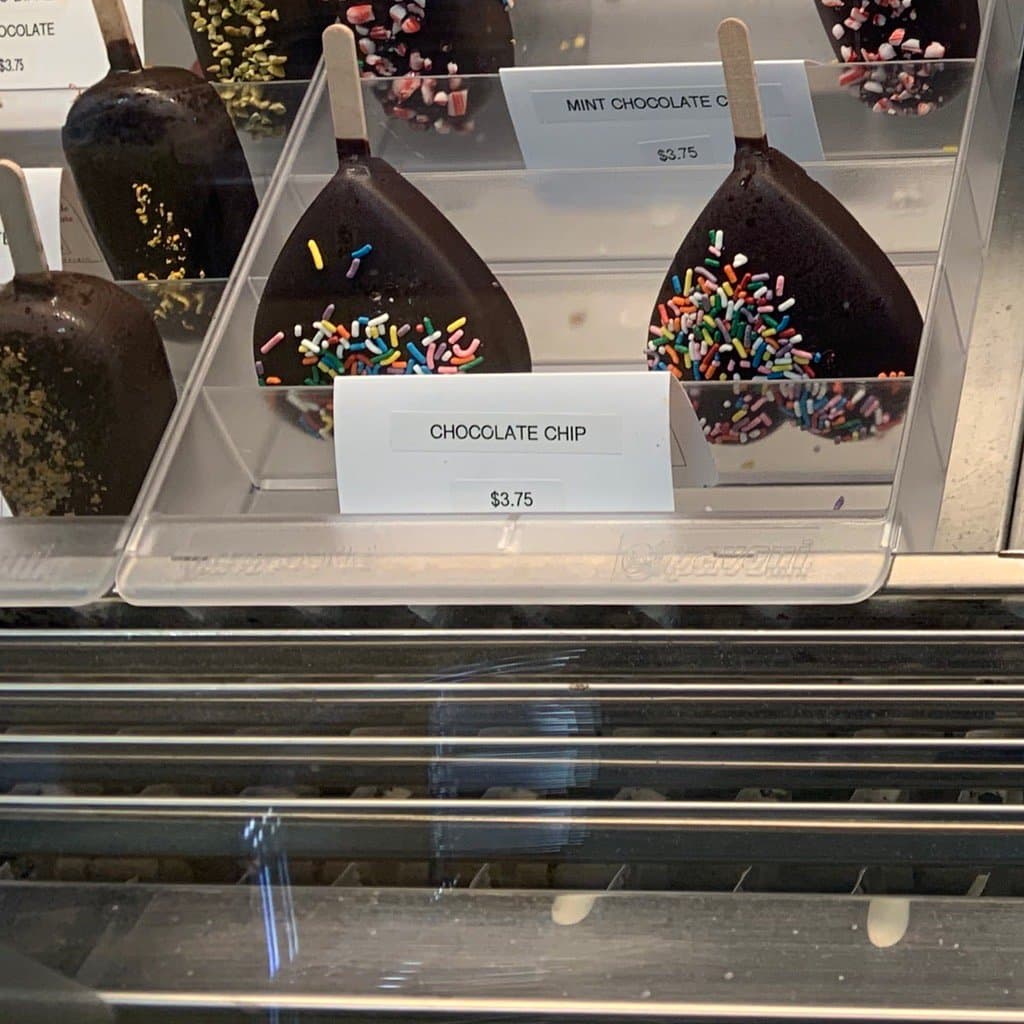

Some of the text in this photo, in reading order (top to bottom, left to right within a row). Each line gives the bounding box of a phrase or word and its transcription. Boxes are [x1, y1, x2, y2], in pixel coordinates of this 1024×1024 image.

[566, 97, 608, 113] MINT
[611, 95, 712, 111] CHOCOLATE
[657, 145, 698, 163] $3.75
[430, 424, 587, 442] CHOCOLATE CHIP
[490, 491, 533, 509] $3.75
